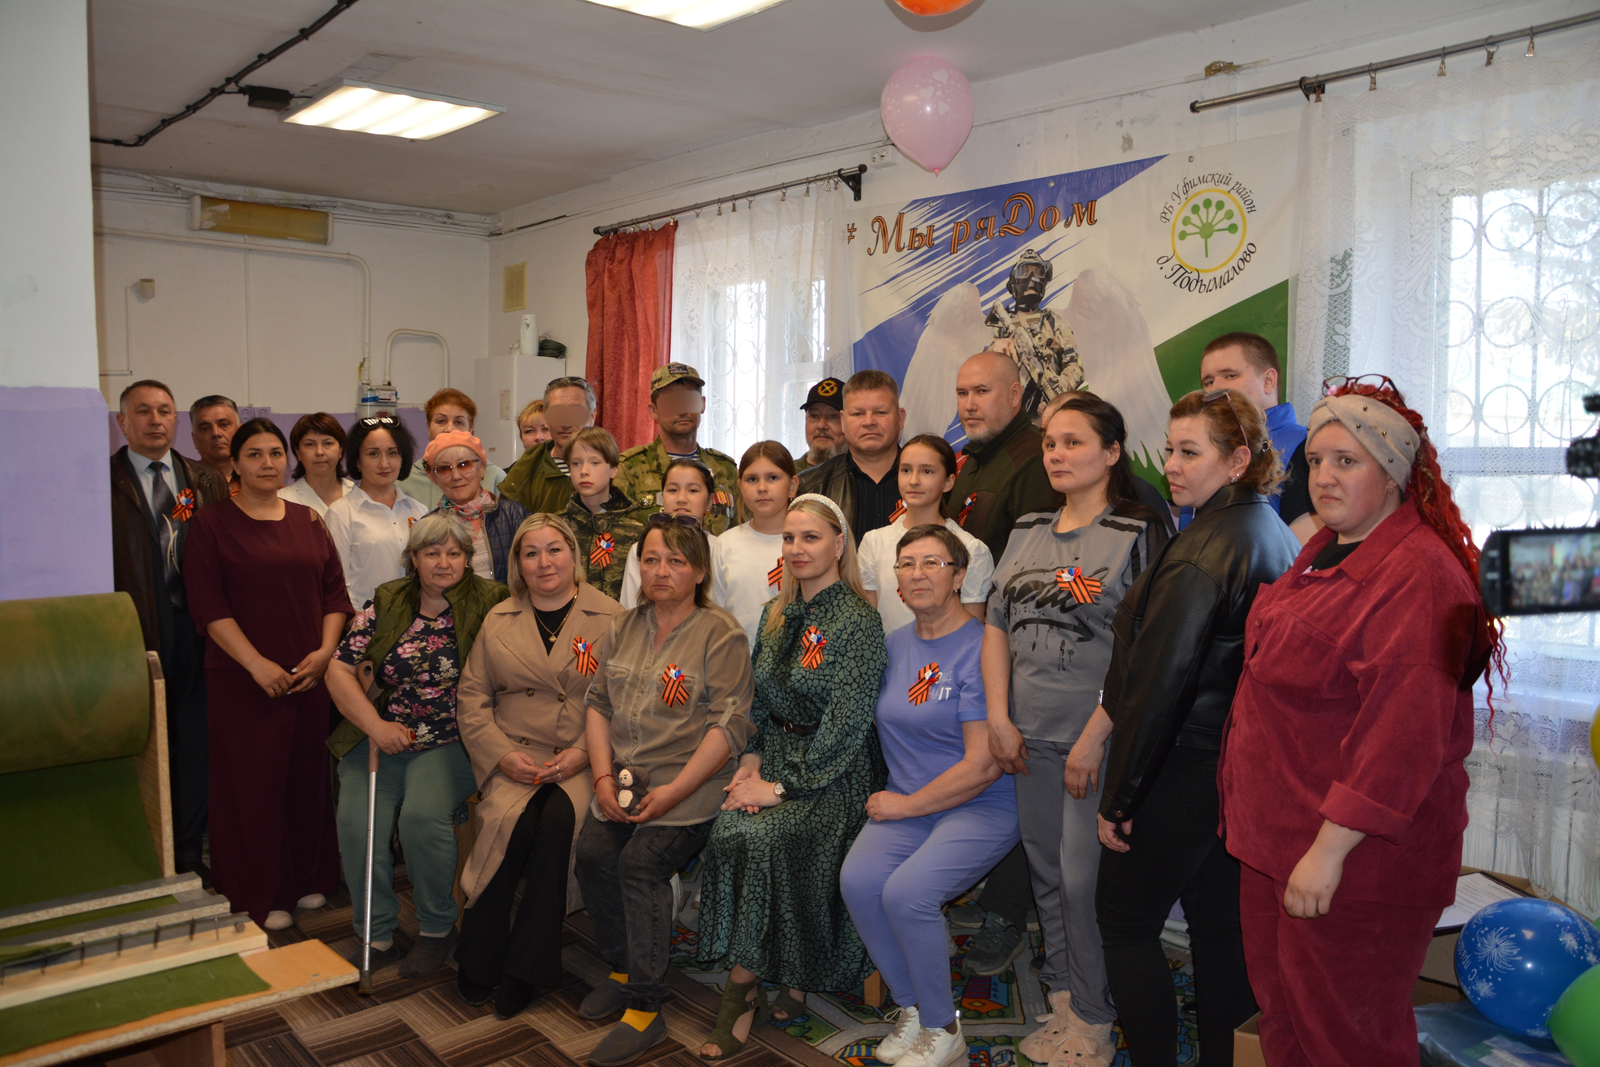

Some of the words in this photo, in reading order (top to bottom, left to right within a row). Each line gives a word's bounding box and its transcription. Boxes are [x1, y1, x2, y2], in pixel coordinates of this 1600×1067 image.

[950, 192, 1098, 255] ряДом
[1160, 202, 1174, 224] РБ
[1171, 172, 1234, 205] Уфимский
[1227, 181, 1257, 214] район
[1156, 249, 1176, 271] д.
[1164, 242, 1257, 294] Подымалово
